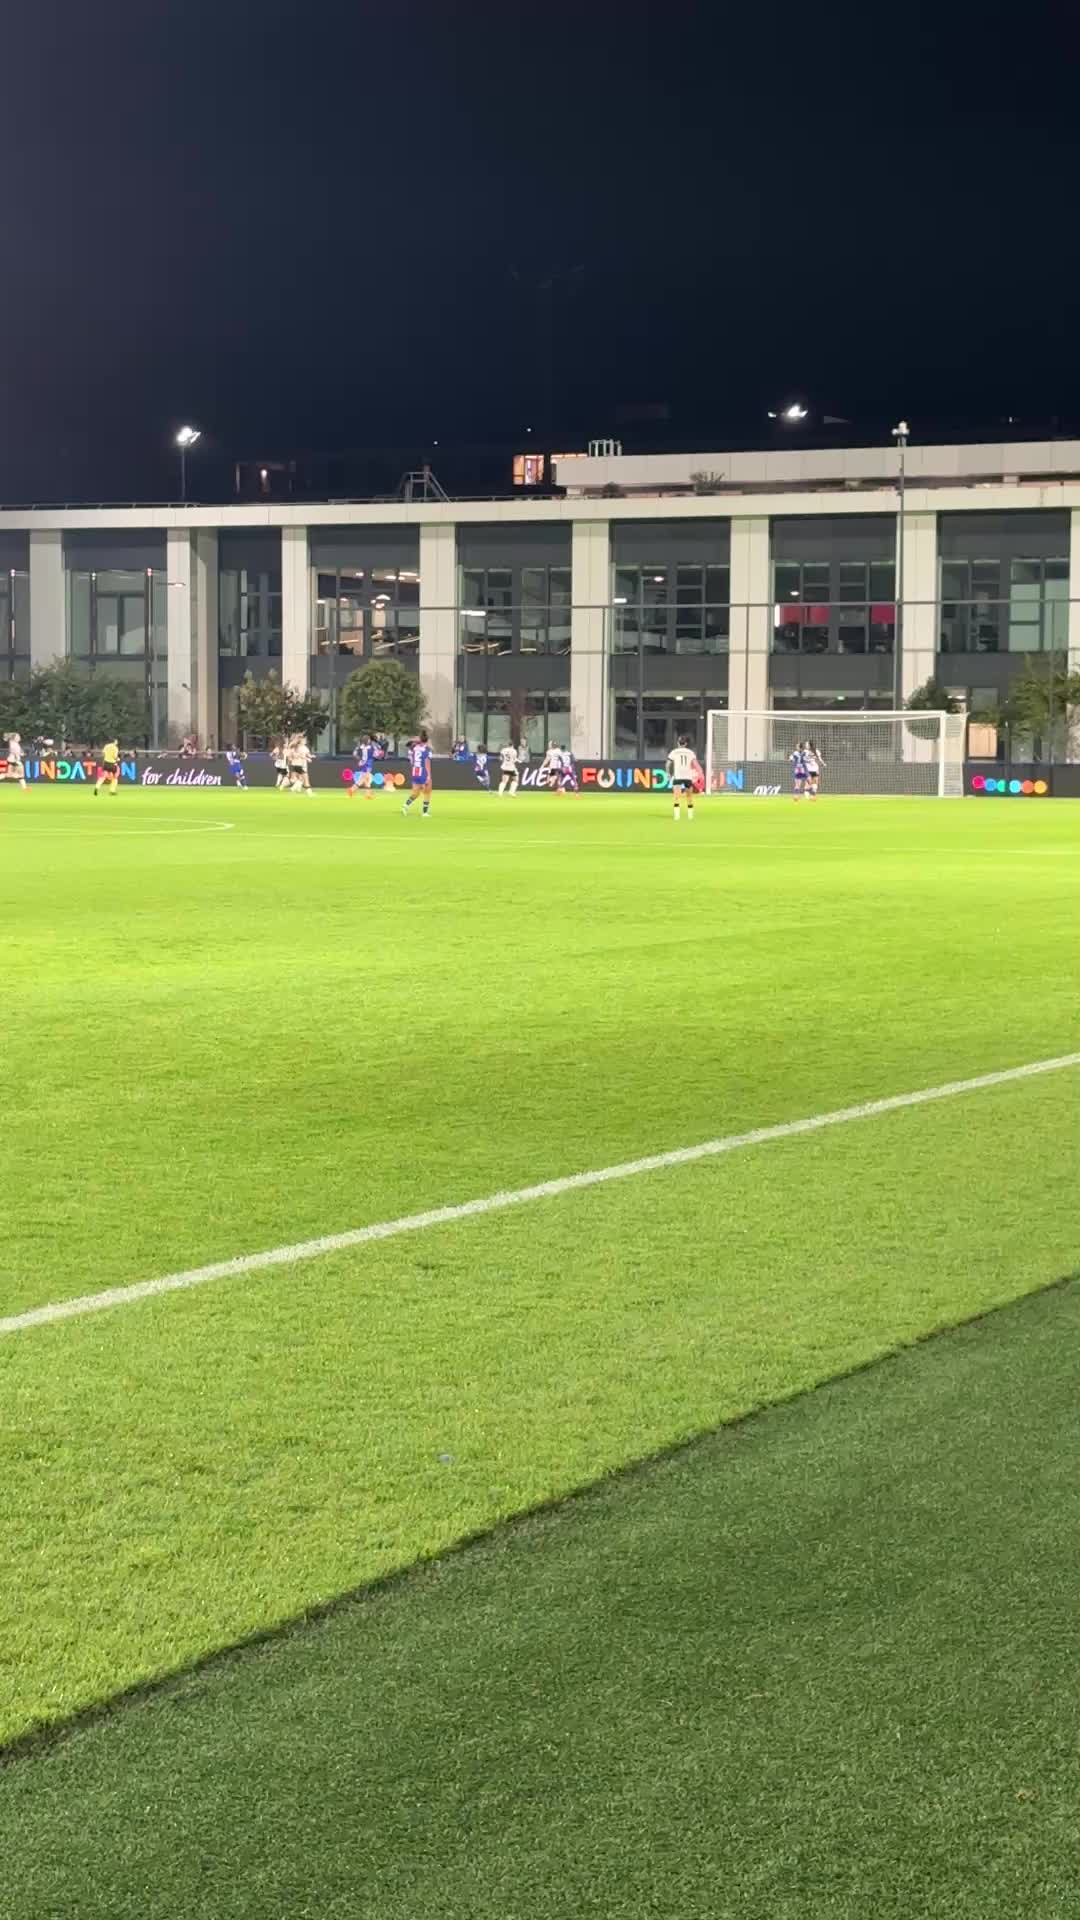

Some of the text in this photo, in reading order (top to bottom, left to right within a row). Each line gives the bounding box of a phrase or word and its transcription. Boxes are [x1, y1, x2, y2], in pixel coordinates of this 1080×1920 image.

[680, 755, 688, 767] 11
[142, 766, 162, 785] for
[166, 768, 221, 785] children
[582, 767, 743, 789] FOUNDN
